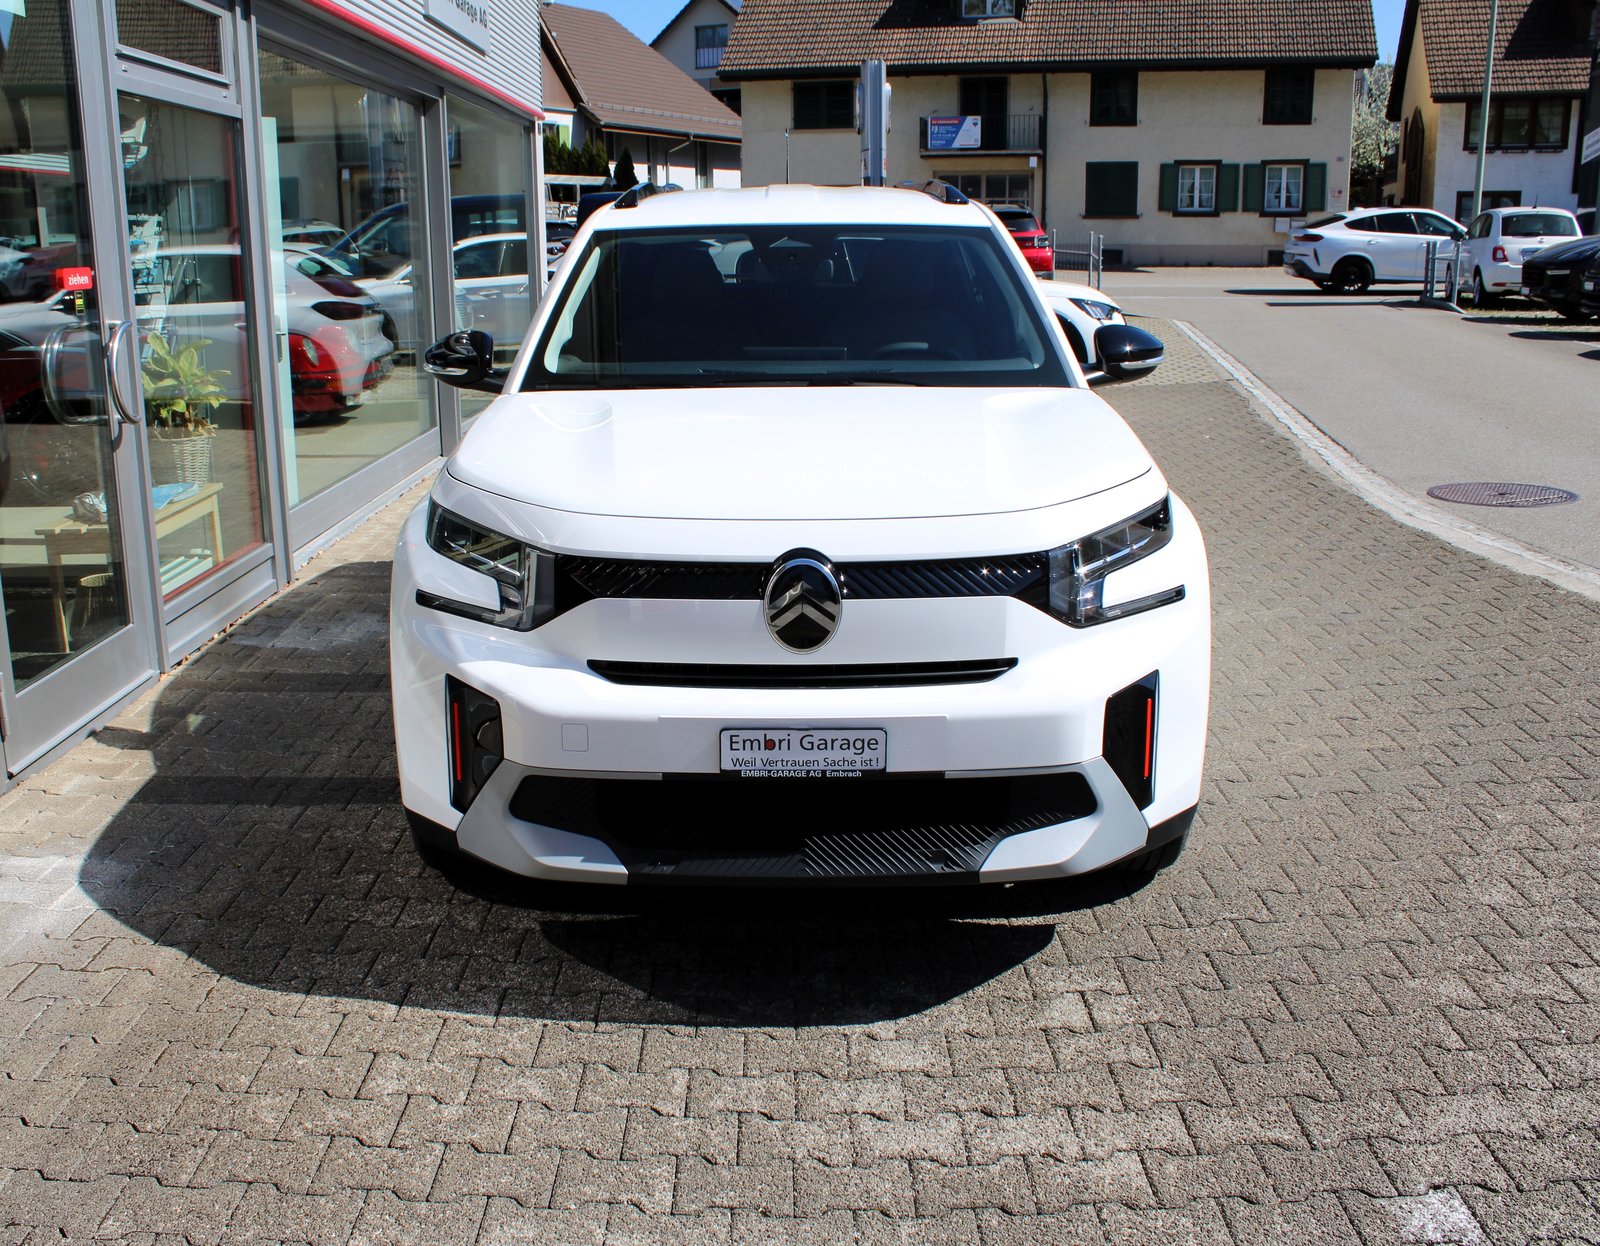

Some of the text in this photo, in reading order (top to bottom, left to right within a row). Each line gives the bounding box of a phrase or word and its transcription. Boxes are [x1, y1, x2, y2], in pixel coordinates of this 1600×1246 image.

[479, 6, 488, 28] AG
[68, 273, 89, 285] ziehen
[730, 733, 879, 755] Embri Garage
[731, 757, 757, 767] Weil
[760, 757, 819, 767] Vertrauen
[823, 757, 857, 767] Sache
[860, 757, 873, 767] ist
